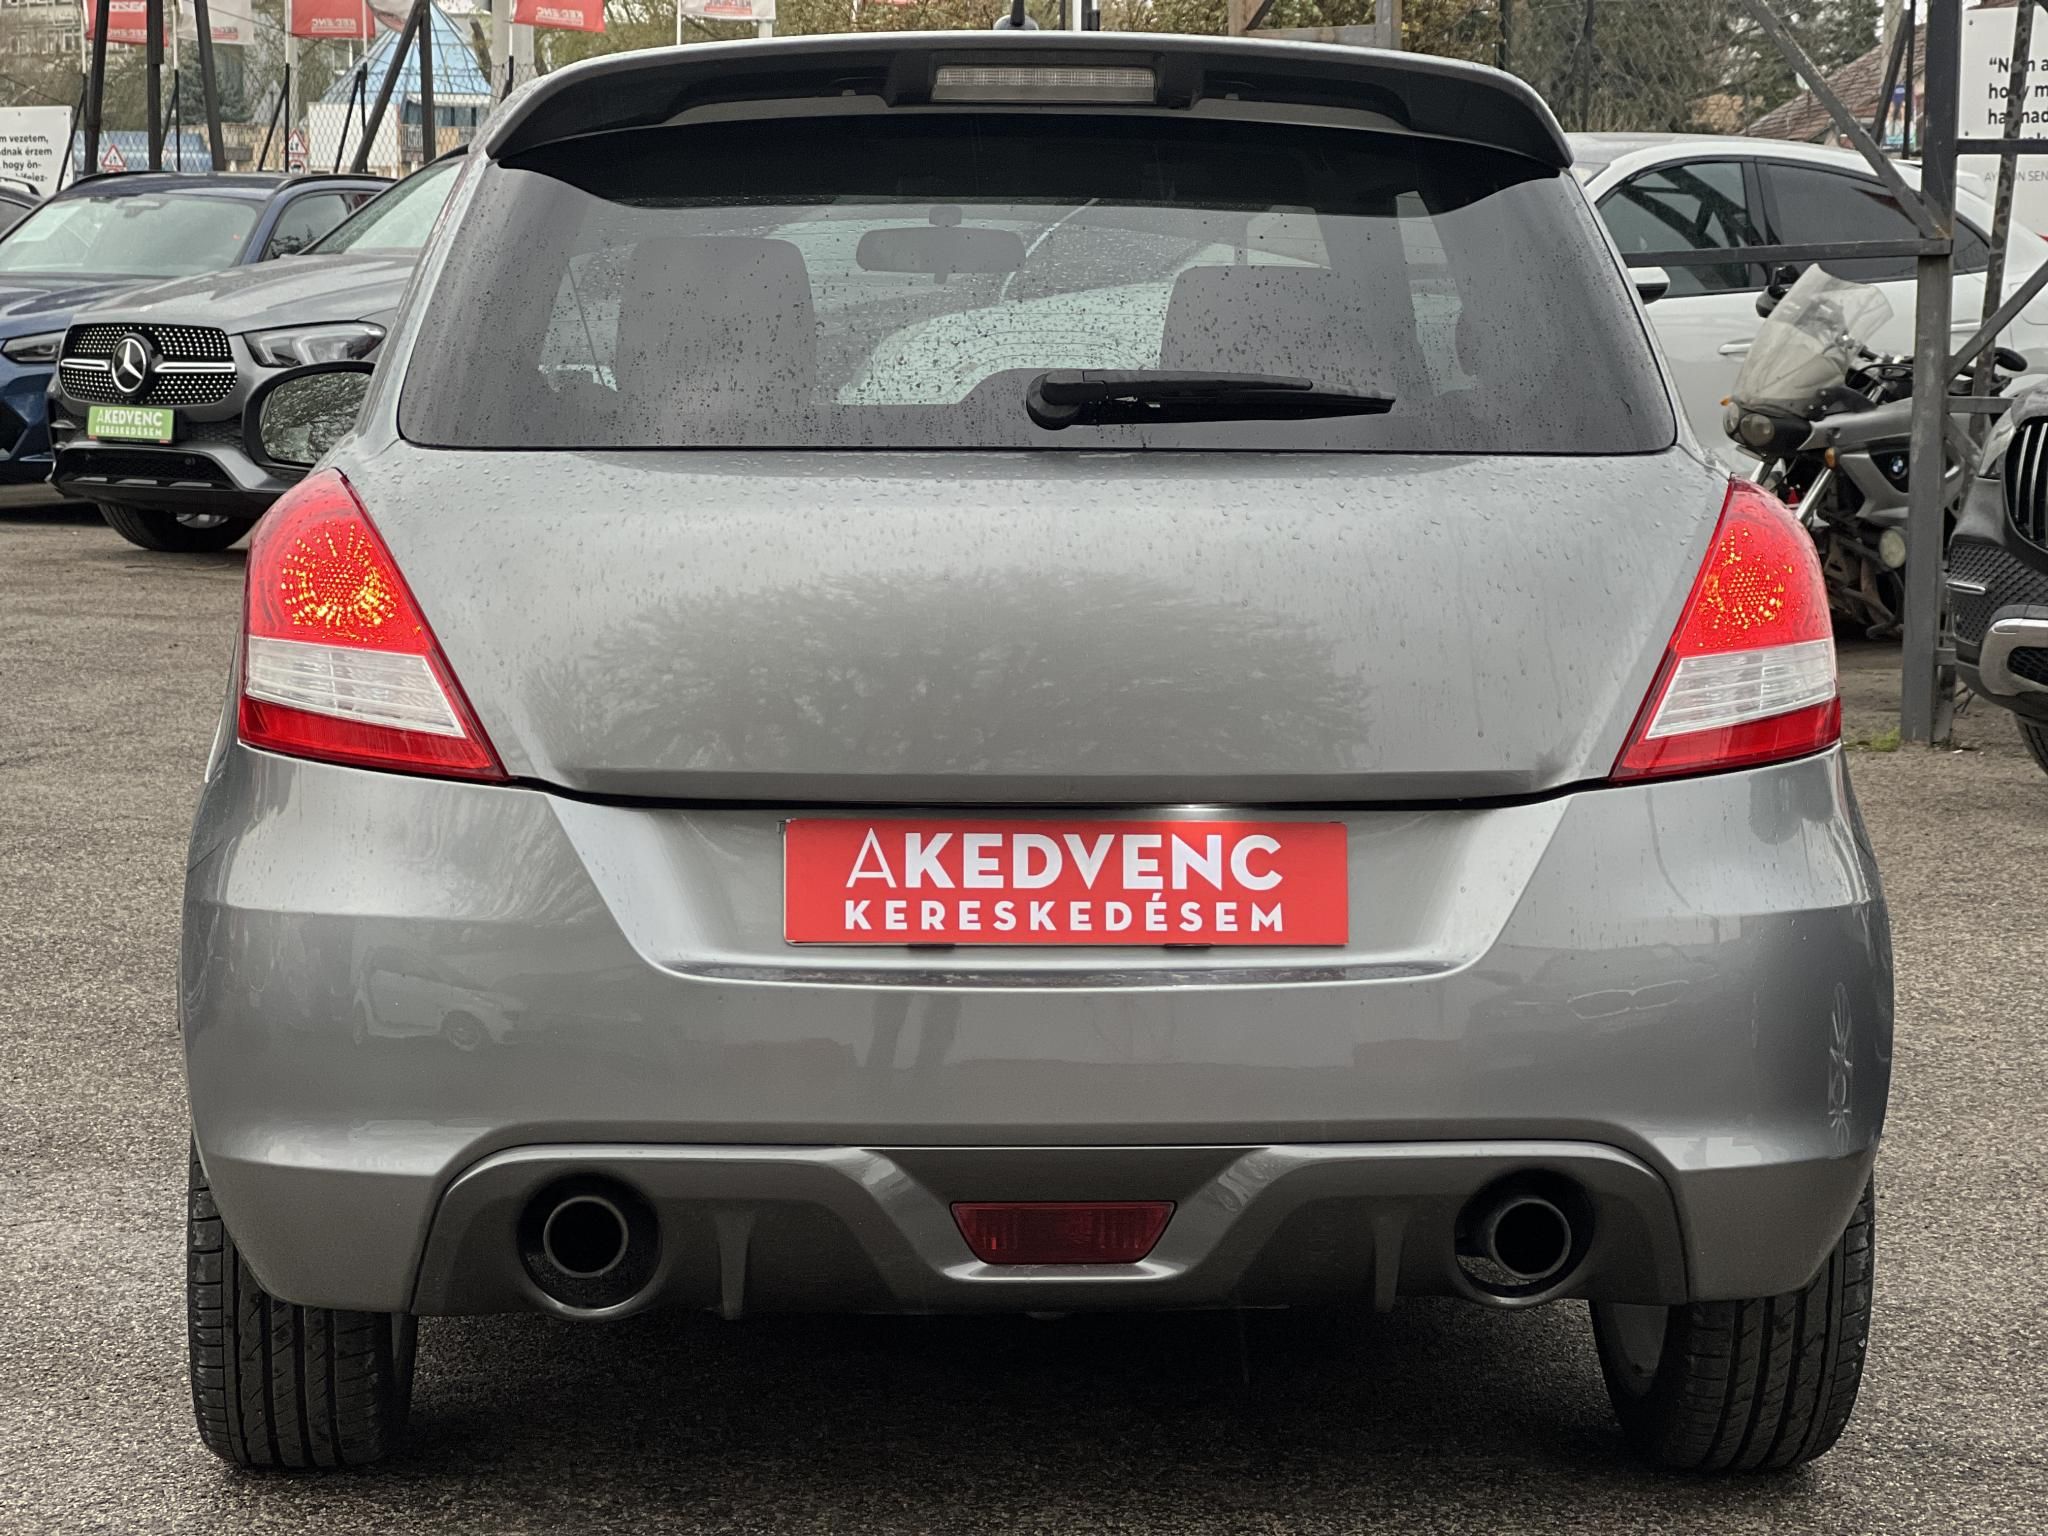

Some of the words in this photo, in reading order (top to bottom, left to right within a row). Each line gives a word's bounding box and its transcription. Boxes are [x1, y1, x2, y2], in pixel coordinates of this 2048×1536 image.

[9, 134, 49, 145] vezetem,
[0, 147, 23, 156] dnak
[25, 146, 53, 156] érzem
[3, 160, 24, 171] hogy
[27, 160, 42, 169] ön-
[97, 409, 163, 426] AKEDVENC
[844, 892, 1284, 933] KERESKEDÉSEM
